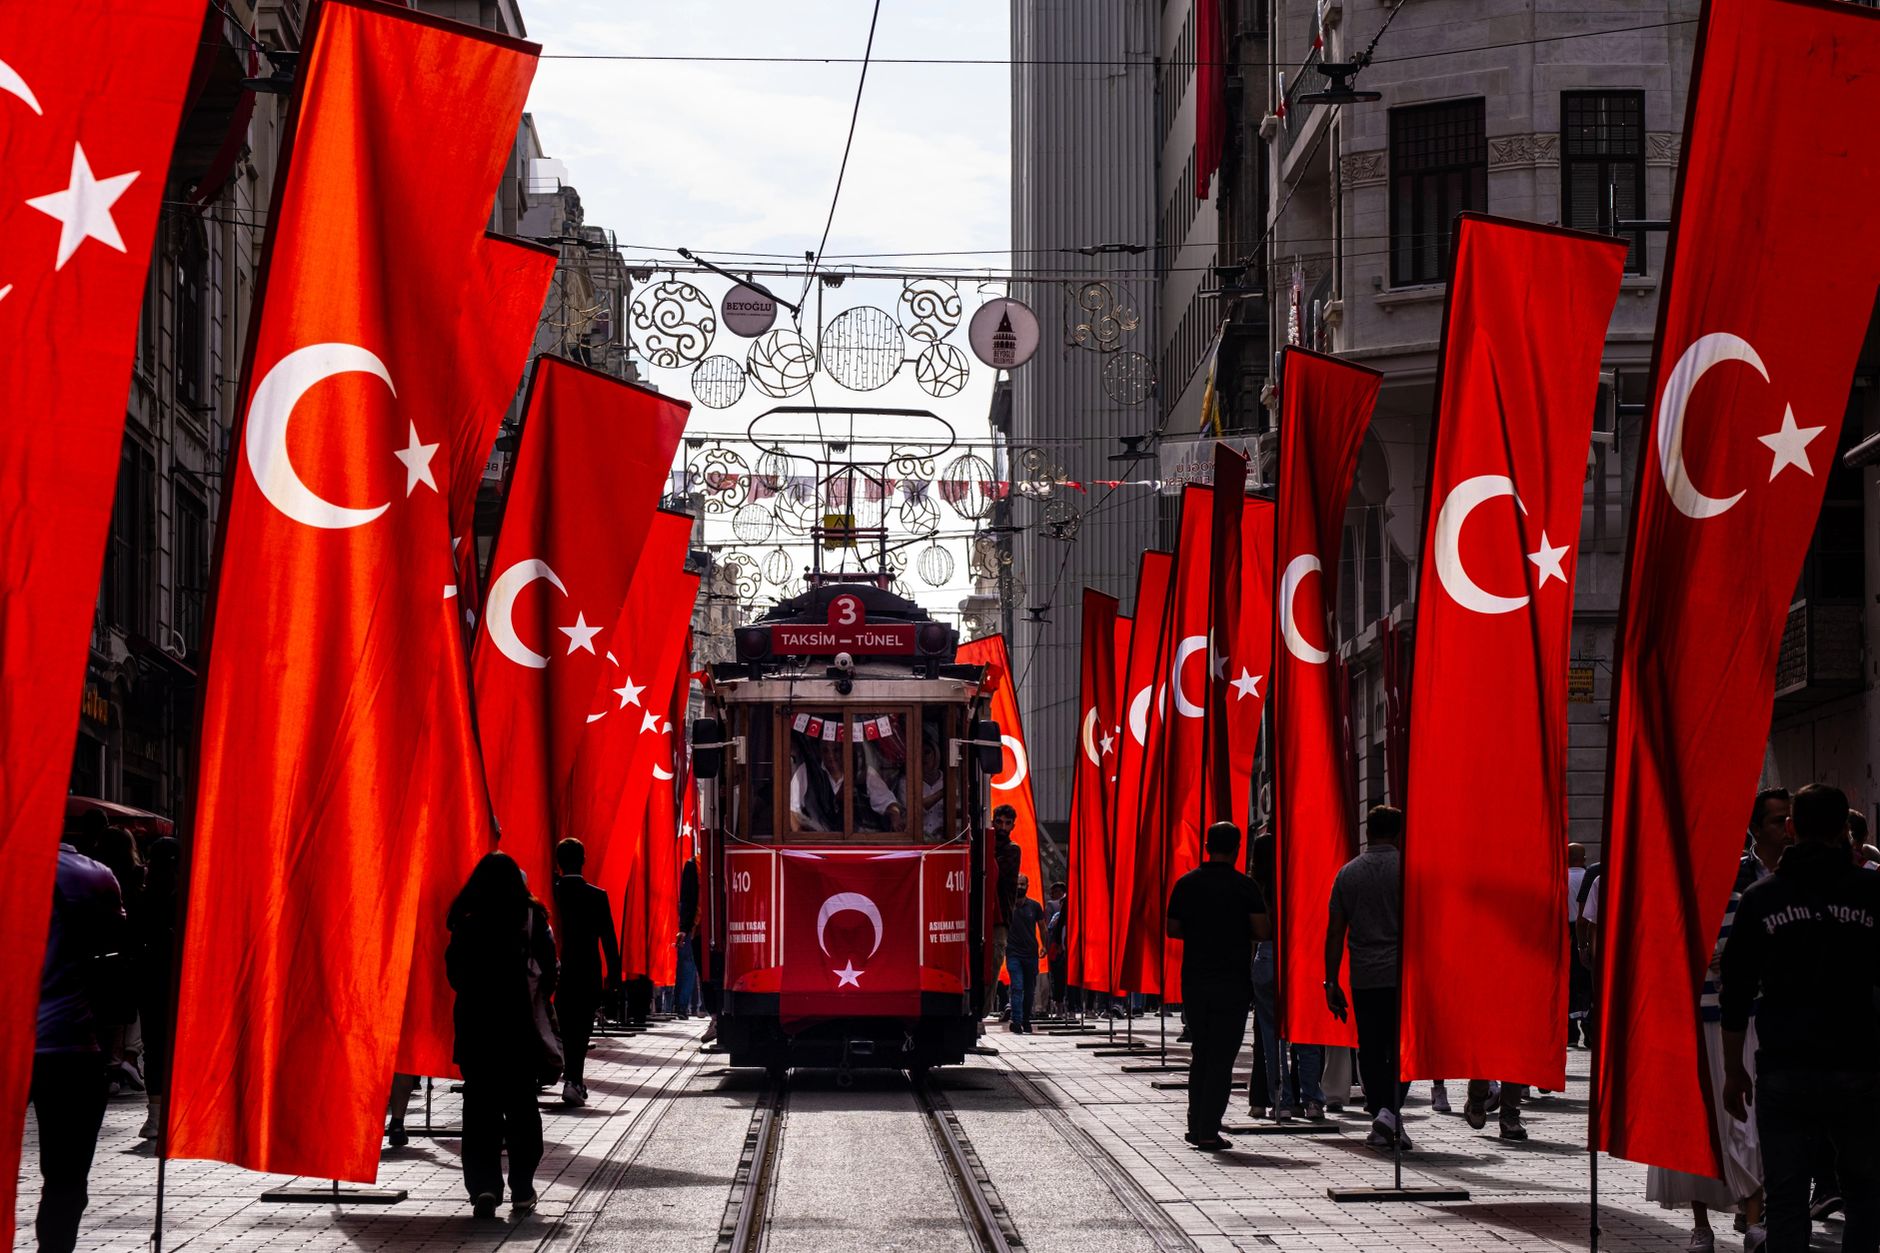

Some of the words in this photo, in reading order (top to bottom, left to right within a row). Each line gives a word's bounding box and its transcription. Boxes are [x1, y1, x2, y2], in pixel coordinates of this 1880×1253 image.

[726, 301, 772, 312] BEYOĞLU
[837, 598, 857, 625] 3
[781, 632, 836, 646] TAKSİM
[855, 632, 904, 646] TÜNEL
[732, 870, 751, 893] 410
[945, 870, 965, 892] 410
